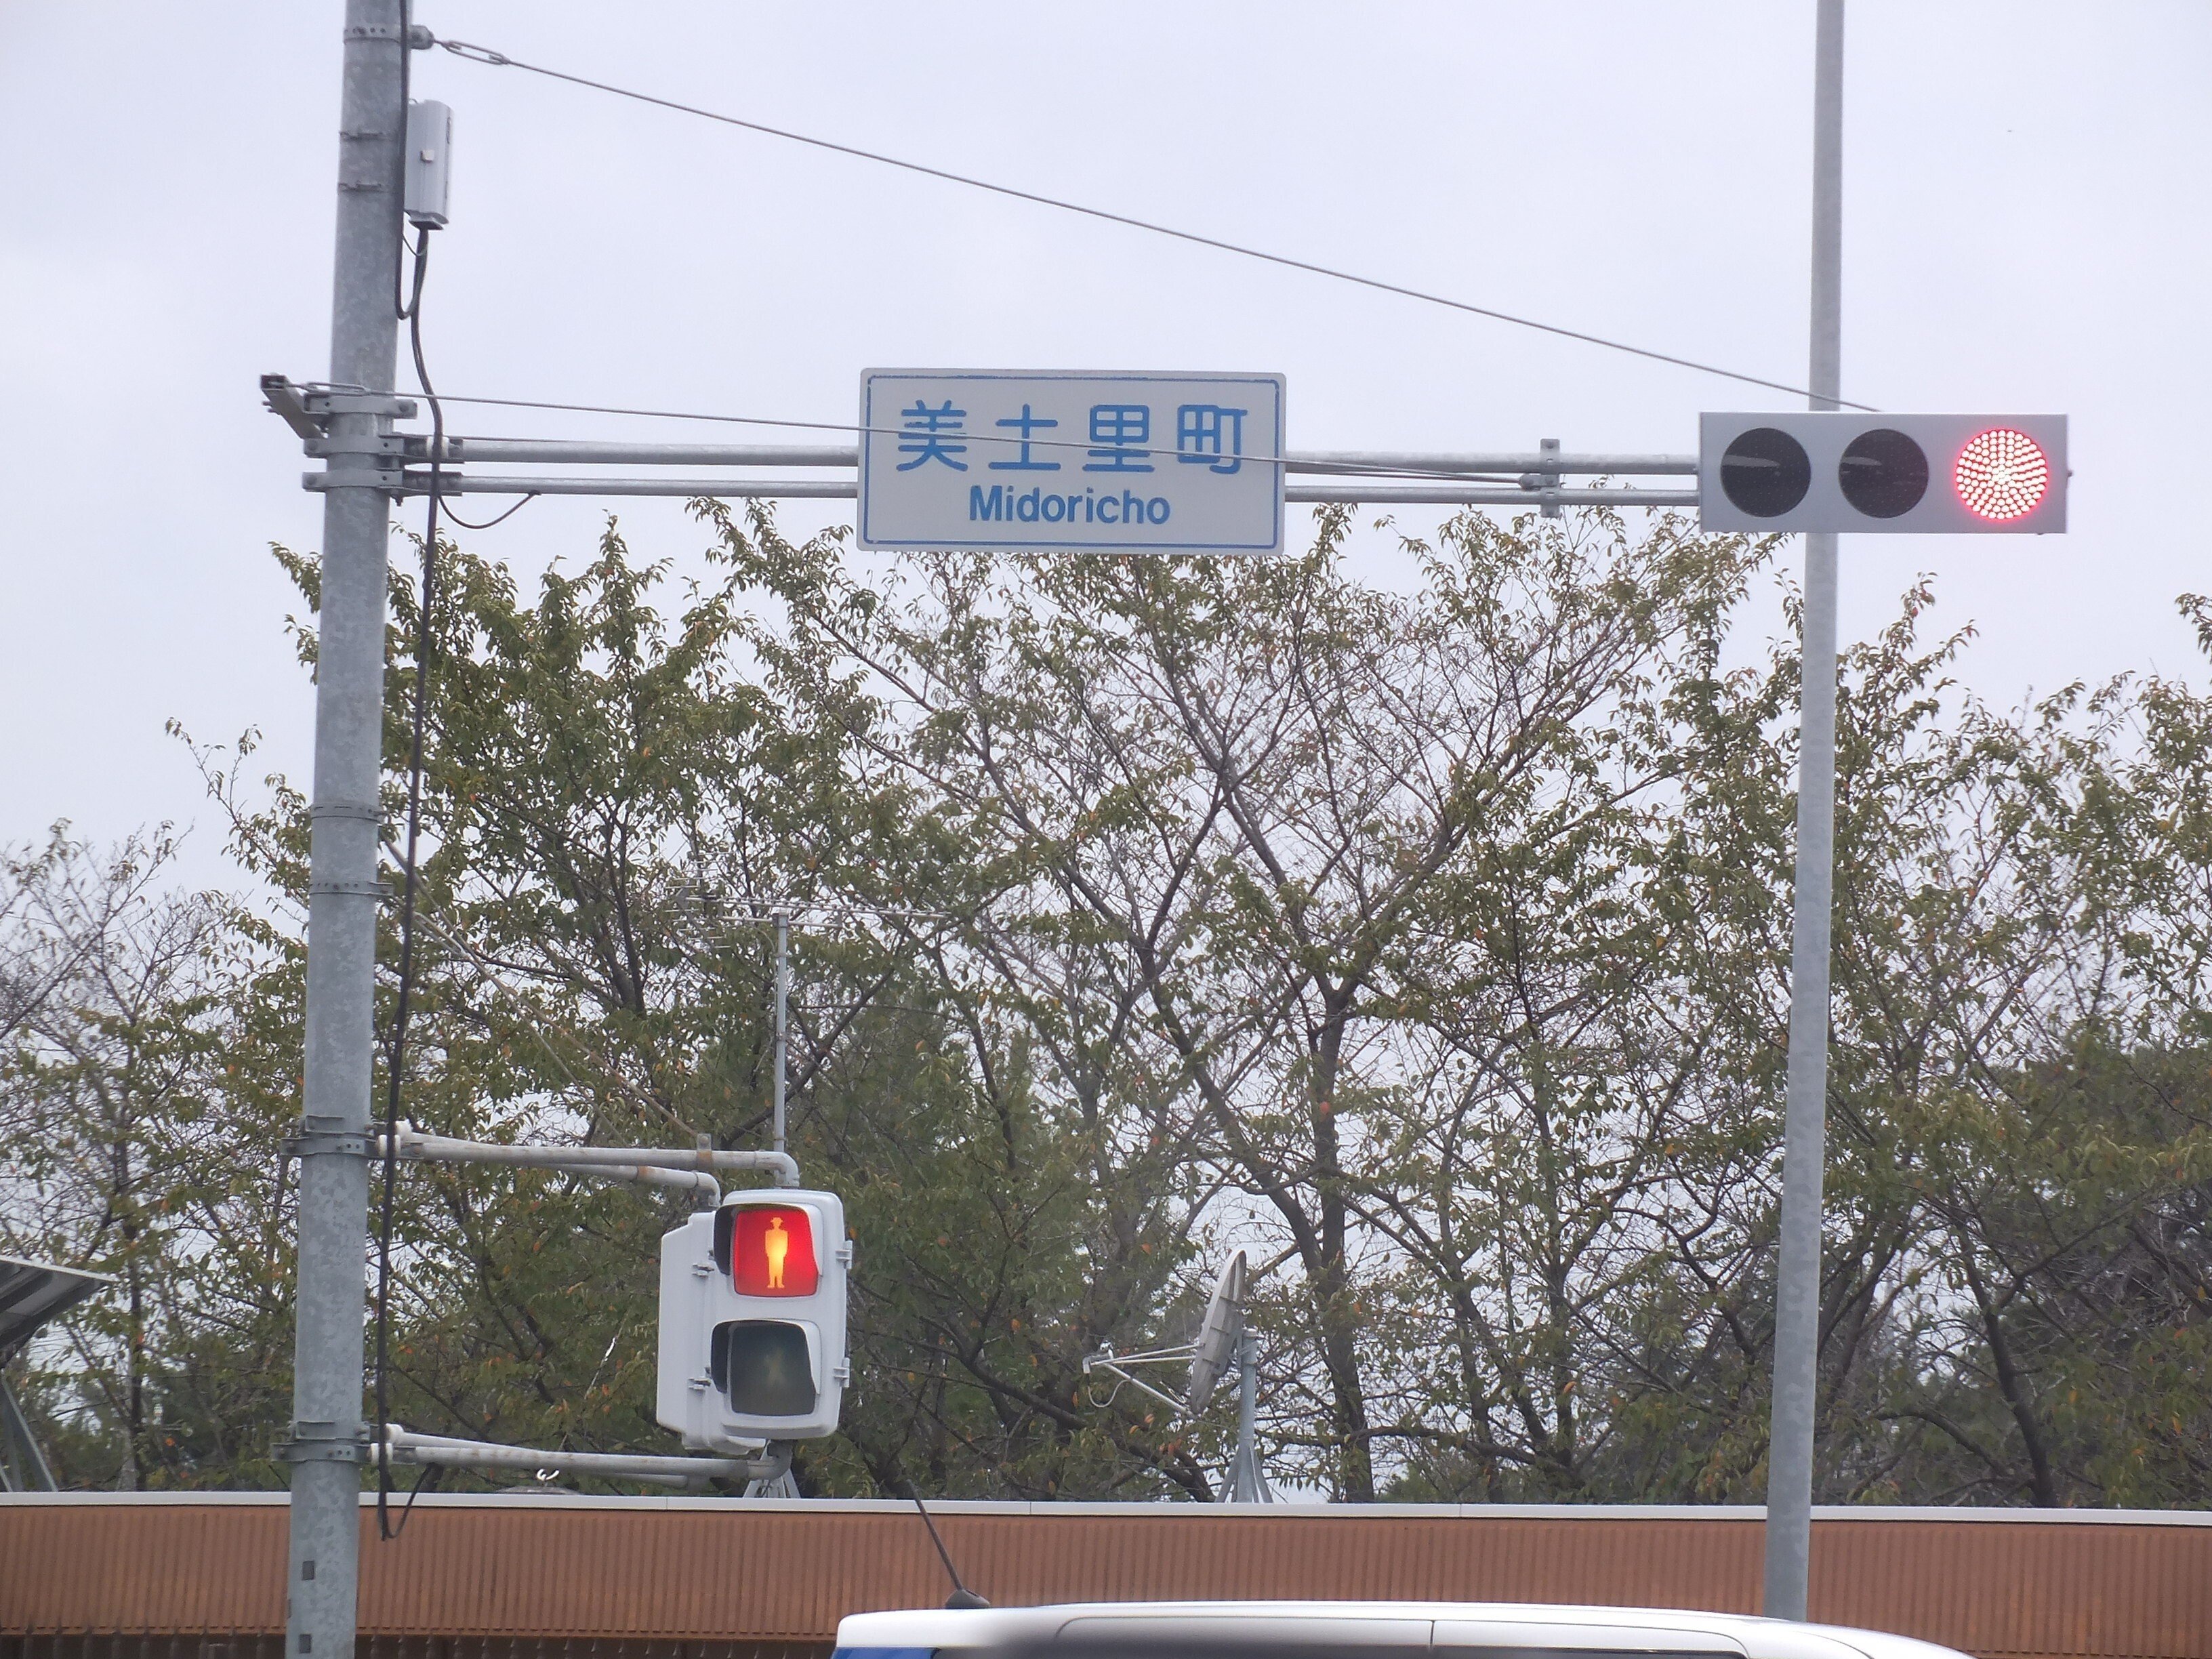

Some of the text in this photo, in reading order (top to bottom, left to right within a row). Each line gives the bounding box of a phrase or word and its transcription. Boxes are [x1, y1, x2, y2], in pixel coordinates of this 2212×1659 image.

[897, 400, 1248, 474] 美土里町
[969, 485, 1170, 524] Midoricho
